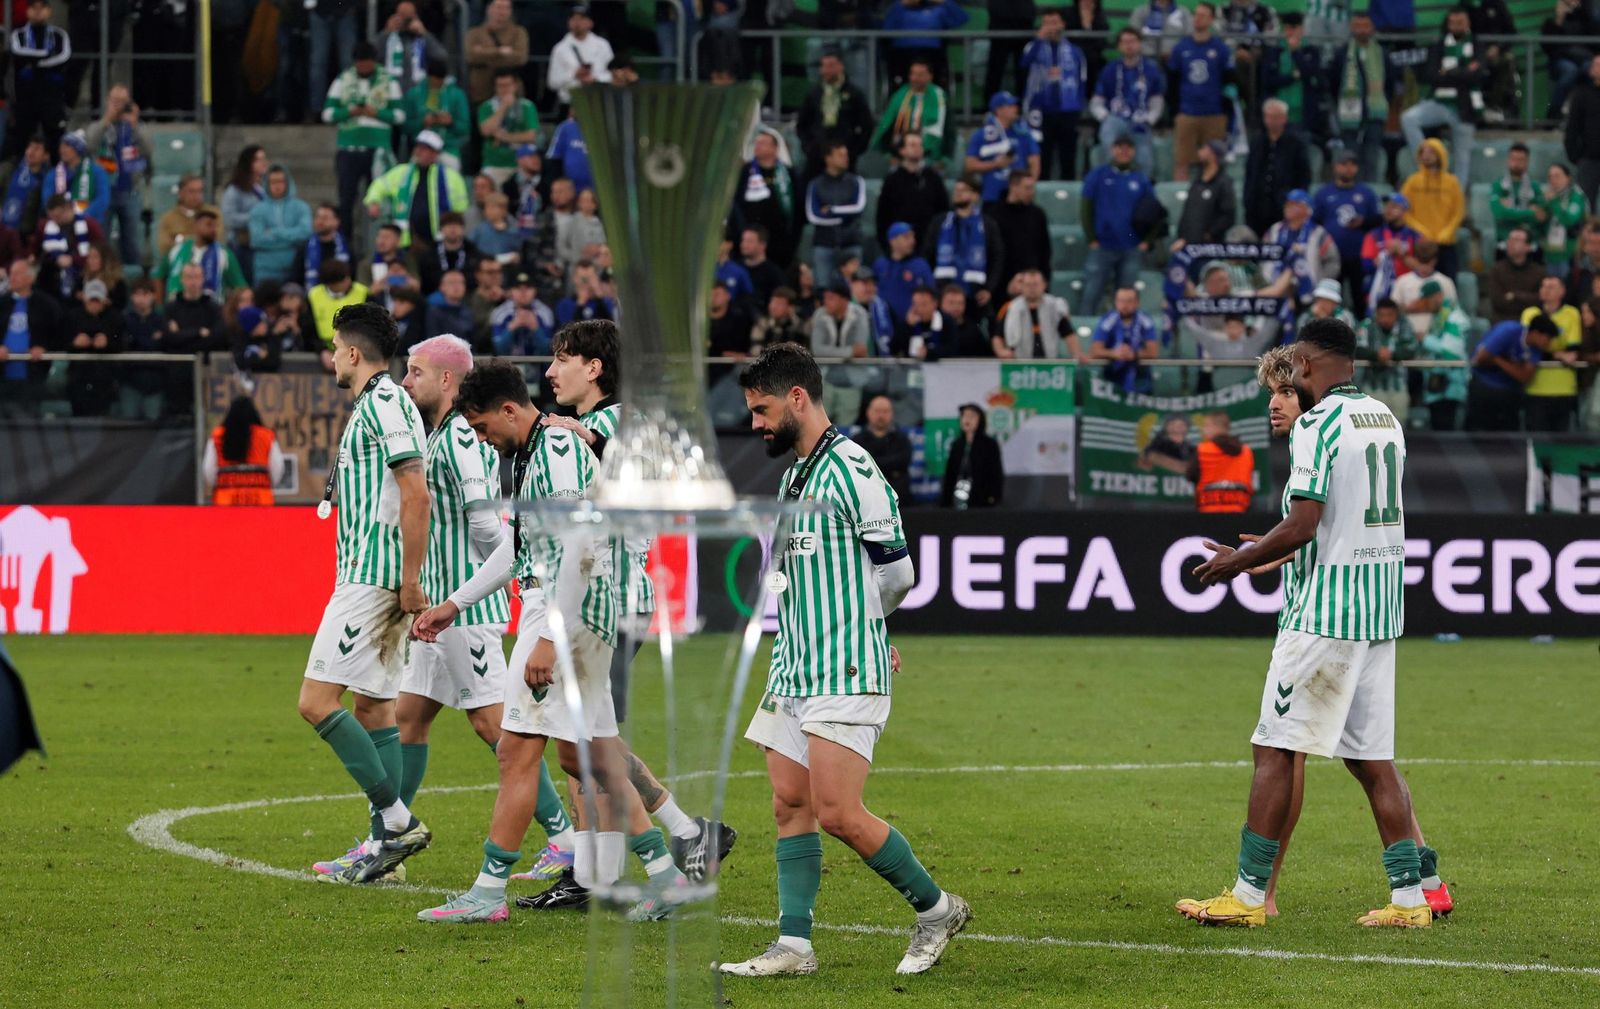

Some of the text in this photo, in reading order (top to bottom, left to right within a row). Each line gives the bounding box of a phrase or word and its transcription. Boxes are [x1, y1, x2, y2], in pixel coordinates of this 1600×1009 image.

[1186, 243, 1284, 259] CHELSEA FC
[1176, 298, 1278, 314] CHELSEA FC
[1090, 377, 1121, 402] EL
[1349, 413, 1397, 431] BAKAMBU
[1089, 470, 1158, 495] TIENE
[1364, 441, 1402, 527] 11
[857, 517, 898, 530] MERITKING
[787, 536, 813, 551] REE
[897, 534, 1600, 614] UEFA COERE
